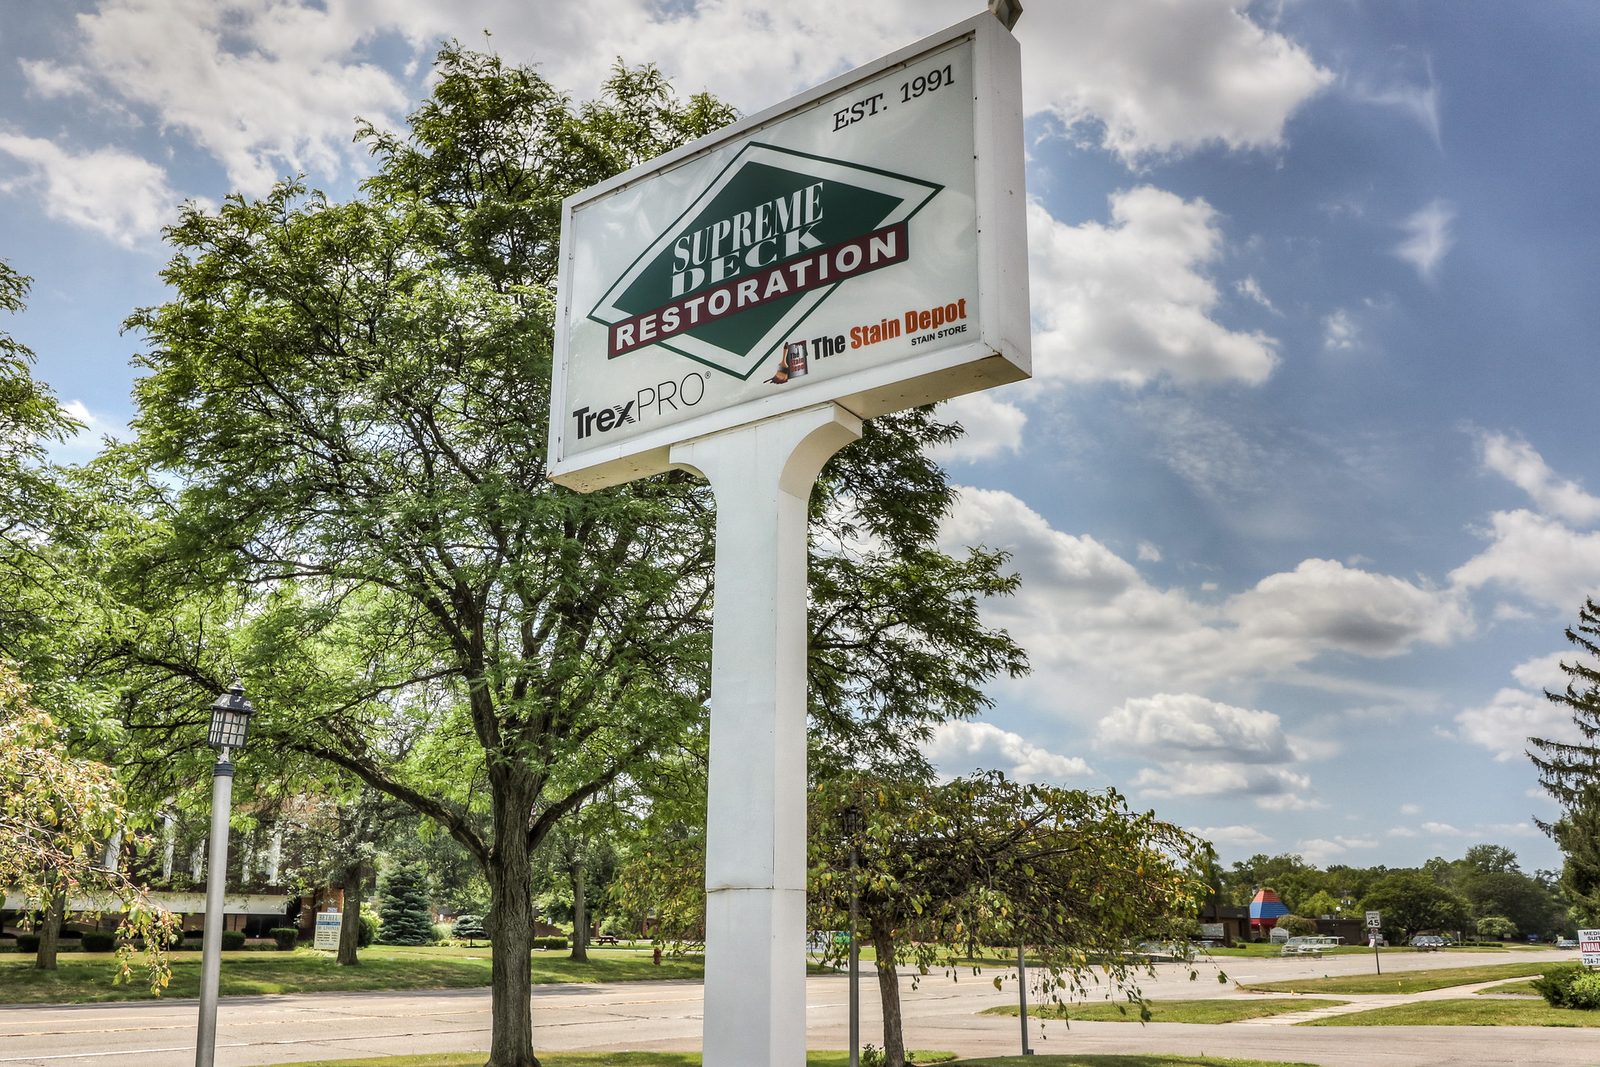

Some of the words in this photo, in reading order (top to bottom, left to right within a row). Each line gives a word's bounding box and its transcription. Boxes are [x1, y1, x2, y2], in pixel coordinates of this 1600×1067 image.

[832, 93, 887, 132] EST.
[900, 64, 954, 103] 1991
[669, 222, 826, 299] DECK
[672, 182, 823, 274] SUPREME
[615, 231, 897, 351] RESTORATION
[811, 335, 846, 360] The
[850, 319, 901, 350] Stain
[905, 298, 967, 334] Depot
[911, 333, 936, 346] STAIN
[937, 324, 968, 339] STORE
